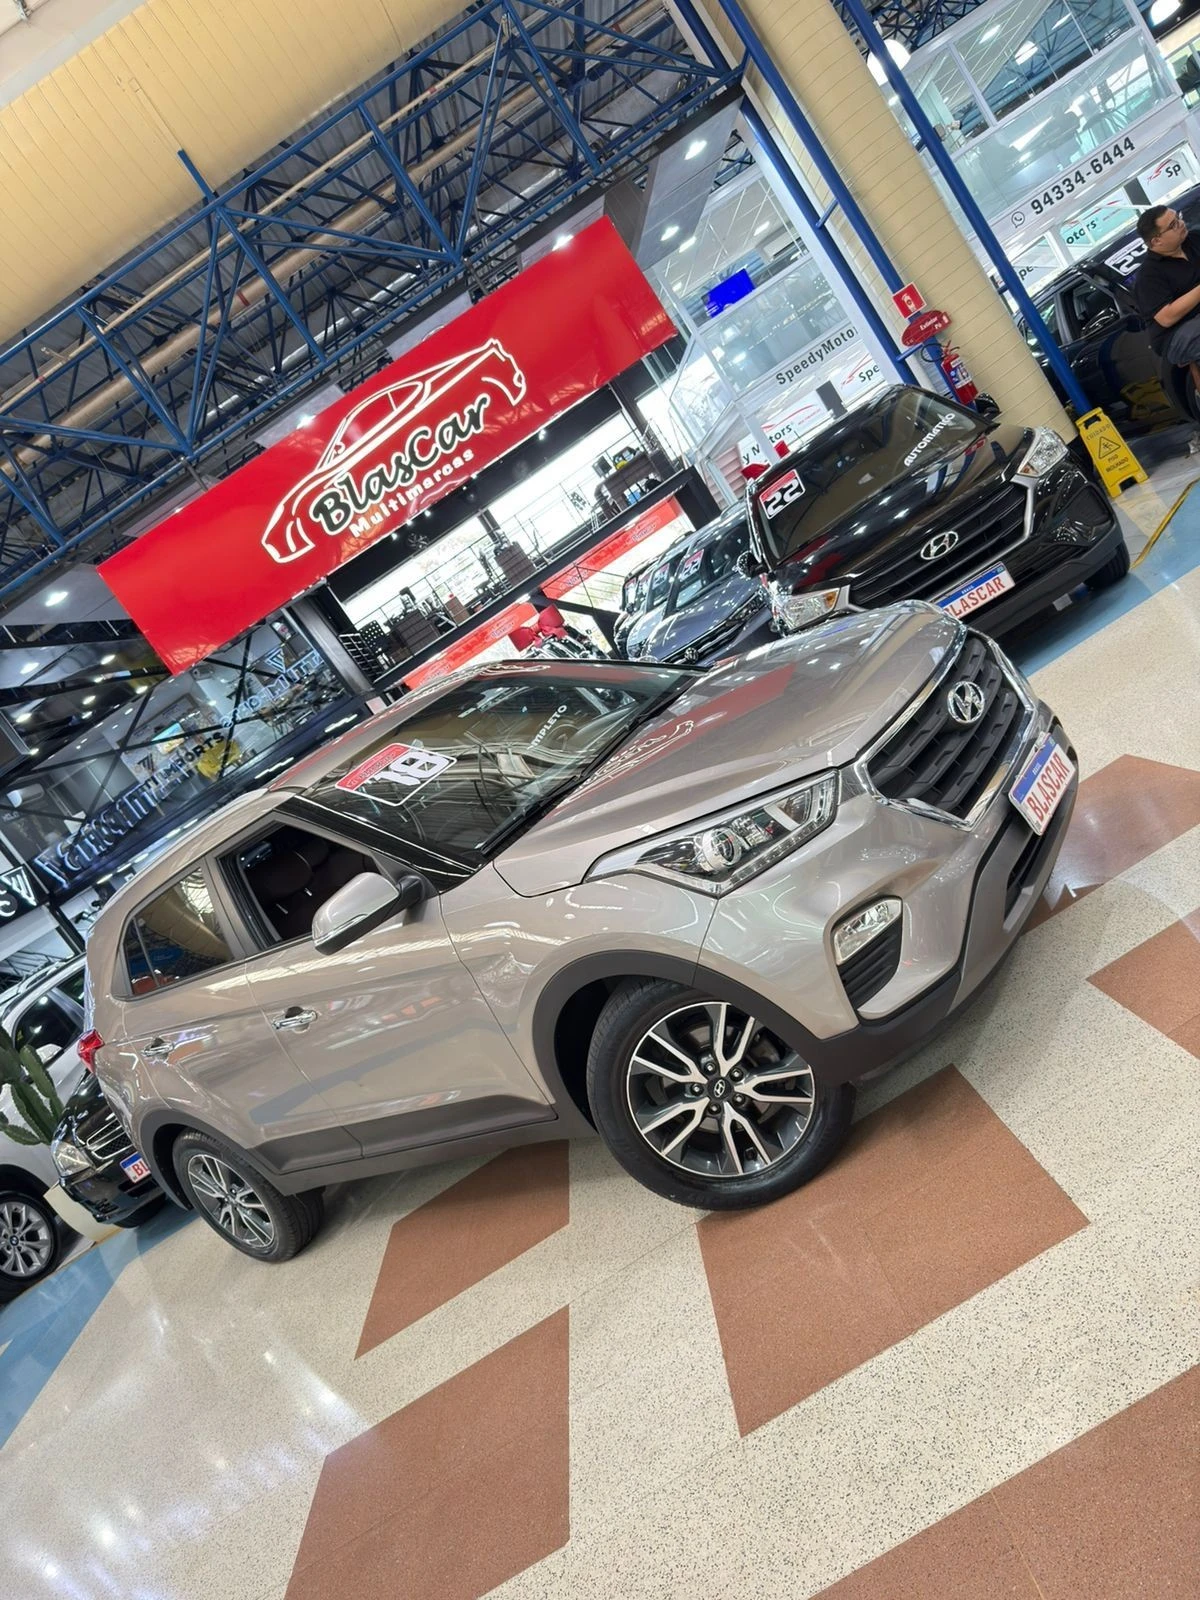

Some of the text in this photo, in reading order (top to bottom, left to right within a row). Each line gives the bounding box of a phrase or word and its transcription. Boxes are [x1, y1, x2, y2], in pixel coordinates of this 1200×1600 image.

[1031, 137, 1136, 215] 94334-6444
[310, 394, 490, 535] BlasCar
[349, 449, 475, 538] Multimarcas
[766, 478, 800, 517] 22
[366, 751, 452, 786] 18
[1027, 751, 1070, 823] BLASCAR
